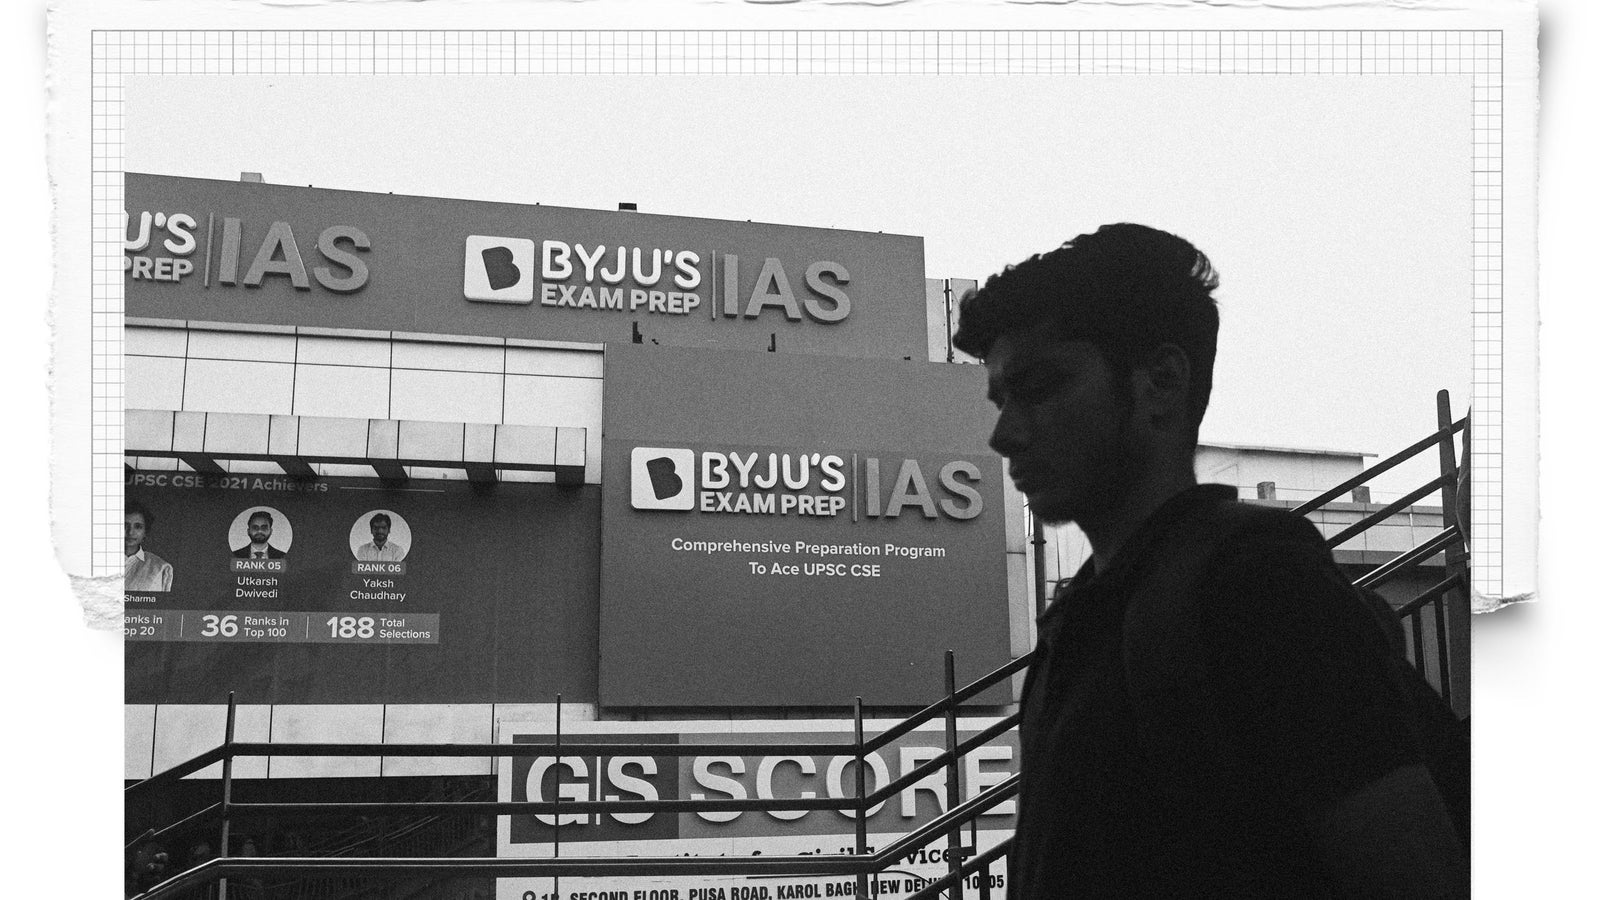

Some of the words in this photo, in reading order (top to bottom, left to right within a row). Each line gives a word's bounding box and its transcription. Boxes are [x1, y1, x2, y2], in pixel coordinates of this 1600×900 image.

[218, 216, 371, 295] IAS
[542, 240, 701, 289] BYJU'S
[723, 254, 852, 325] IAS
[541, 283, 624, 310] EXAM
[630, 289, 701, 314] PREP
[701, 451, 846, 493] BYJU'S
[172, 475, 204, 488] CSE
[865, 457, 984, 521] IAS
[700, 492, 775, 514] EXAM
[781, 494, 846, 517] PREP
[671, 538, 791, 555] Comprehensive
[795, 541, 881, 557] Preparation
[885, 544, 946, 559] Program
[236, 561, 265, 570] RANK
[268, 561, 281, 570] 05
[357, 564, 386, 573] RANK
[388, 564, 401, 573] 06
[749, 562, 767, 575] To
[771, 563, 800, 575] Ace
[804, 563, 847, 577] UPSC
[850, 564, 881, 577] CSE
[237, 576, 278, 586] Utkarsh
[363, 579, 394, 588] Yaksh
[235, 589, 278, 598] Dwivedi
[350, 591, 406, 602] Chaudhary
[153, 615, 163, 624] in
[201, 614, 239, 637] 36
[244, 616, 277, 626] Ranks
[279, 617, 289, 626] in
[380, 618, 405, 627] Total
[140, 626, 155, 636] 20
[244, 628, 265, 638] Top
[268, 628, 287, 637] 100
[326, 616, 375, 639] 188
[379, 629, 431, 639] Selections
[689, 888, 726, 900] PUSA
[731, 886, 772, 900] ROAD,
[777, 884, 821, 900] KAROL
